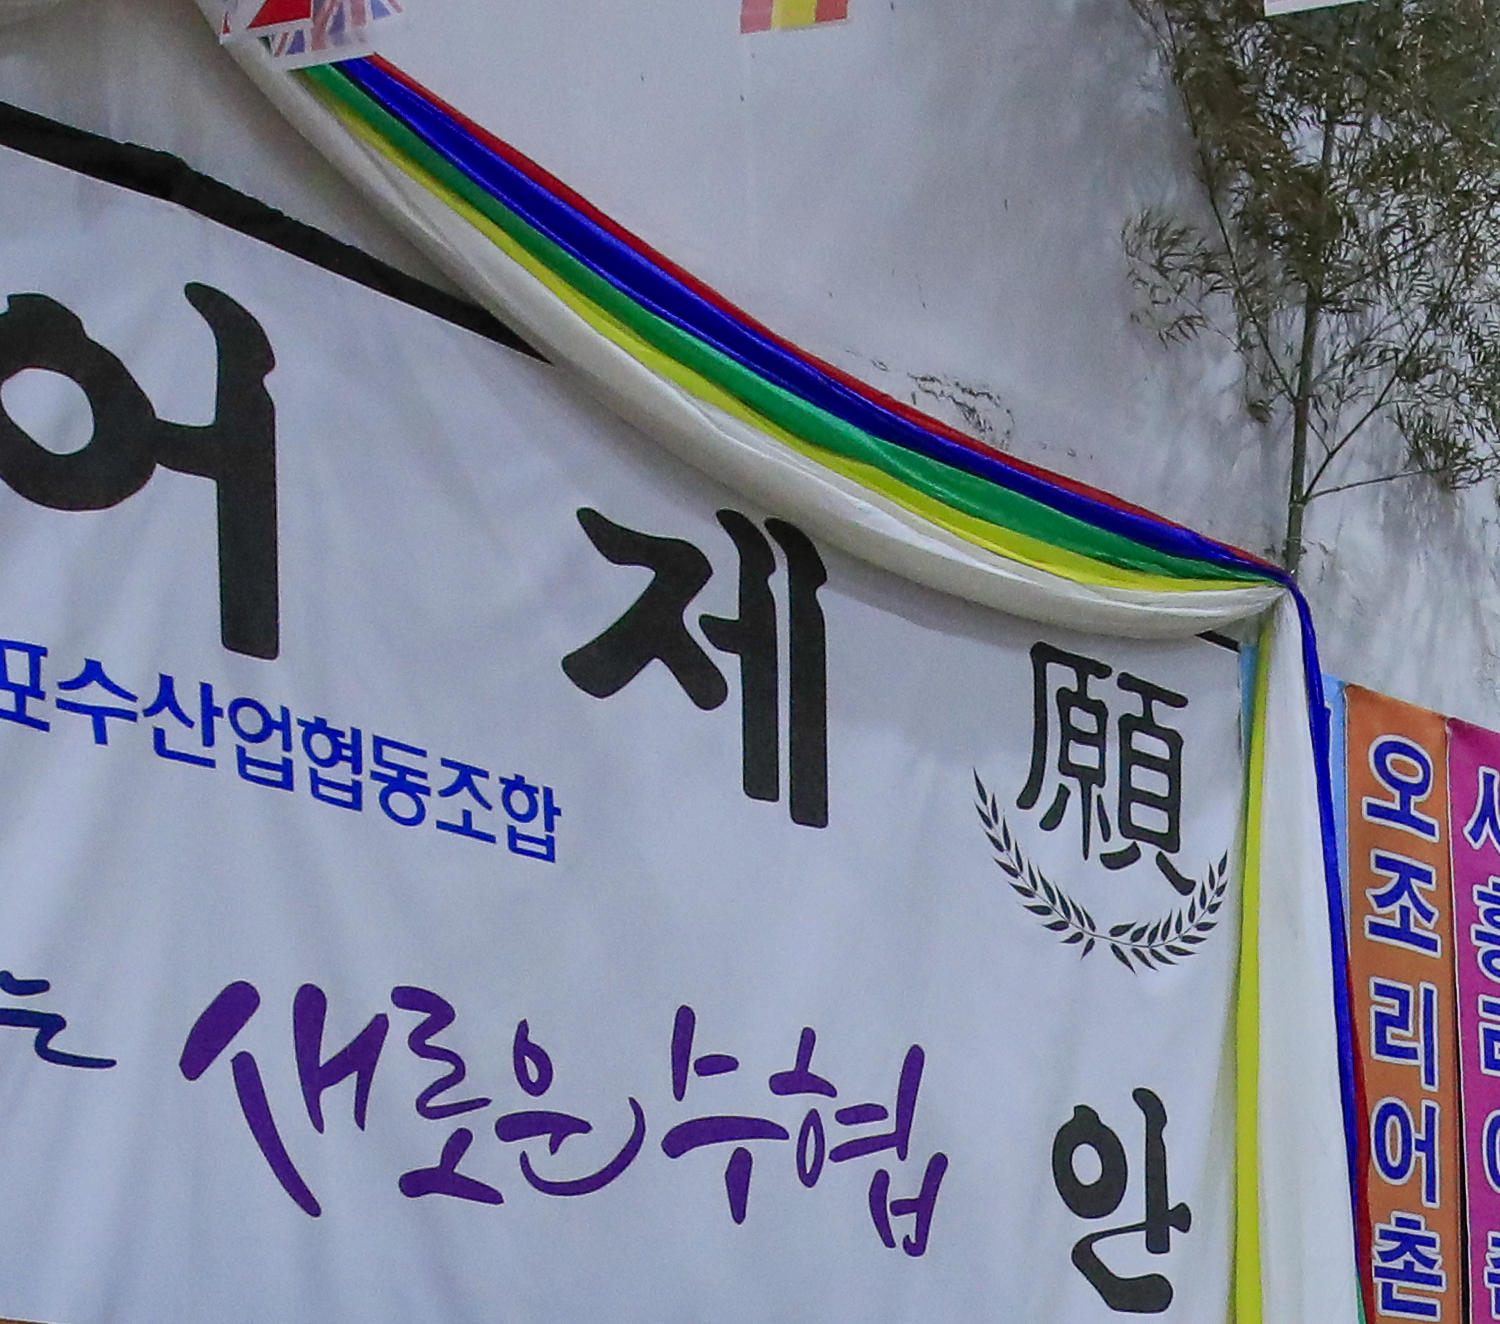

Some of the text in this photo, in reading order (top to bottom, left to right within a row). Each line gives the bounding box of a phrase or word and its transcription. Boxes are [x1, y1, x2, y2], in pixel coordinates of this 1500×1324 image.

[1017, 641, 1197, 898] 願
[181, 981, 644, 1216] 새로운
[662, 1004, 947, 1258] 수협
